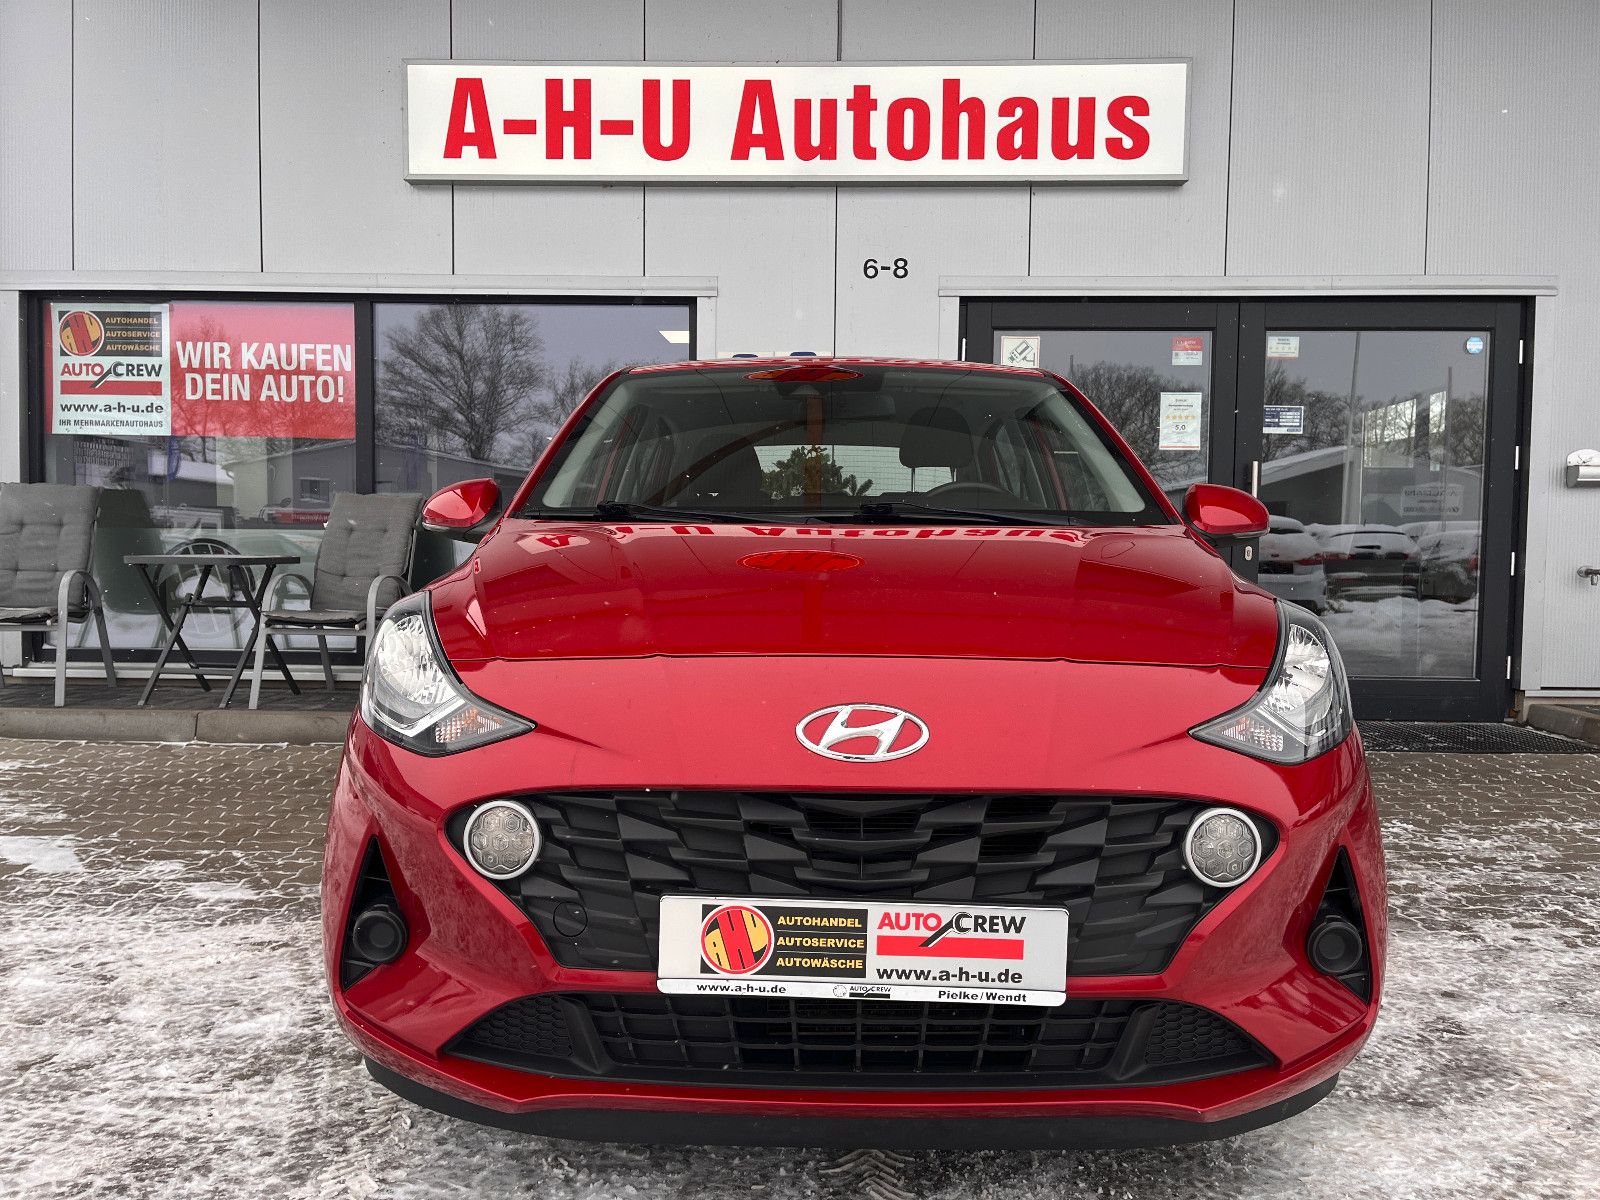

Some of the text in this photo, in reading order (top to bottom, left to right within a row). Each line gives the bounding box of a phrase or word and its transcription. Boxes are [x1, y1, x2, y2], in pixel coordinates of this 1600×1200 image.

[443, 77, 1150, 162] A-H-U Autohaus
[862, 257, 909, 280] 6-8
[105, 330, 161, 338] AUTOSERVICE
[106, 343, 161, 351] AUTOWÄSCHE
[176, 341, 352, 372] WIR KAUFEN
[60, 361, 163, 377] AUTO CREW
[185, 372, 344, 403] DEIN AUTO!
[60, 402, 164, 414] www.a-h-u.de
[73, 419, 163, 428] MEHRMARKENAUTOHAUS
[777, 915, 862, 928] AUTOHANDEL
[877, 911, 1026, 934] AUTO CREW
[776, 936, 865, 948] AUTOSERVICE
[776, 957, 864, 969] AUTOWÄSCHE
[876, 967, 1023, 984] www.a-h-u.de
[697, 983, 787, 994] www.a-h-u.de
